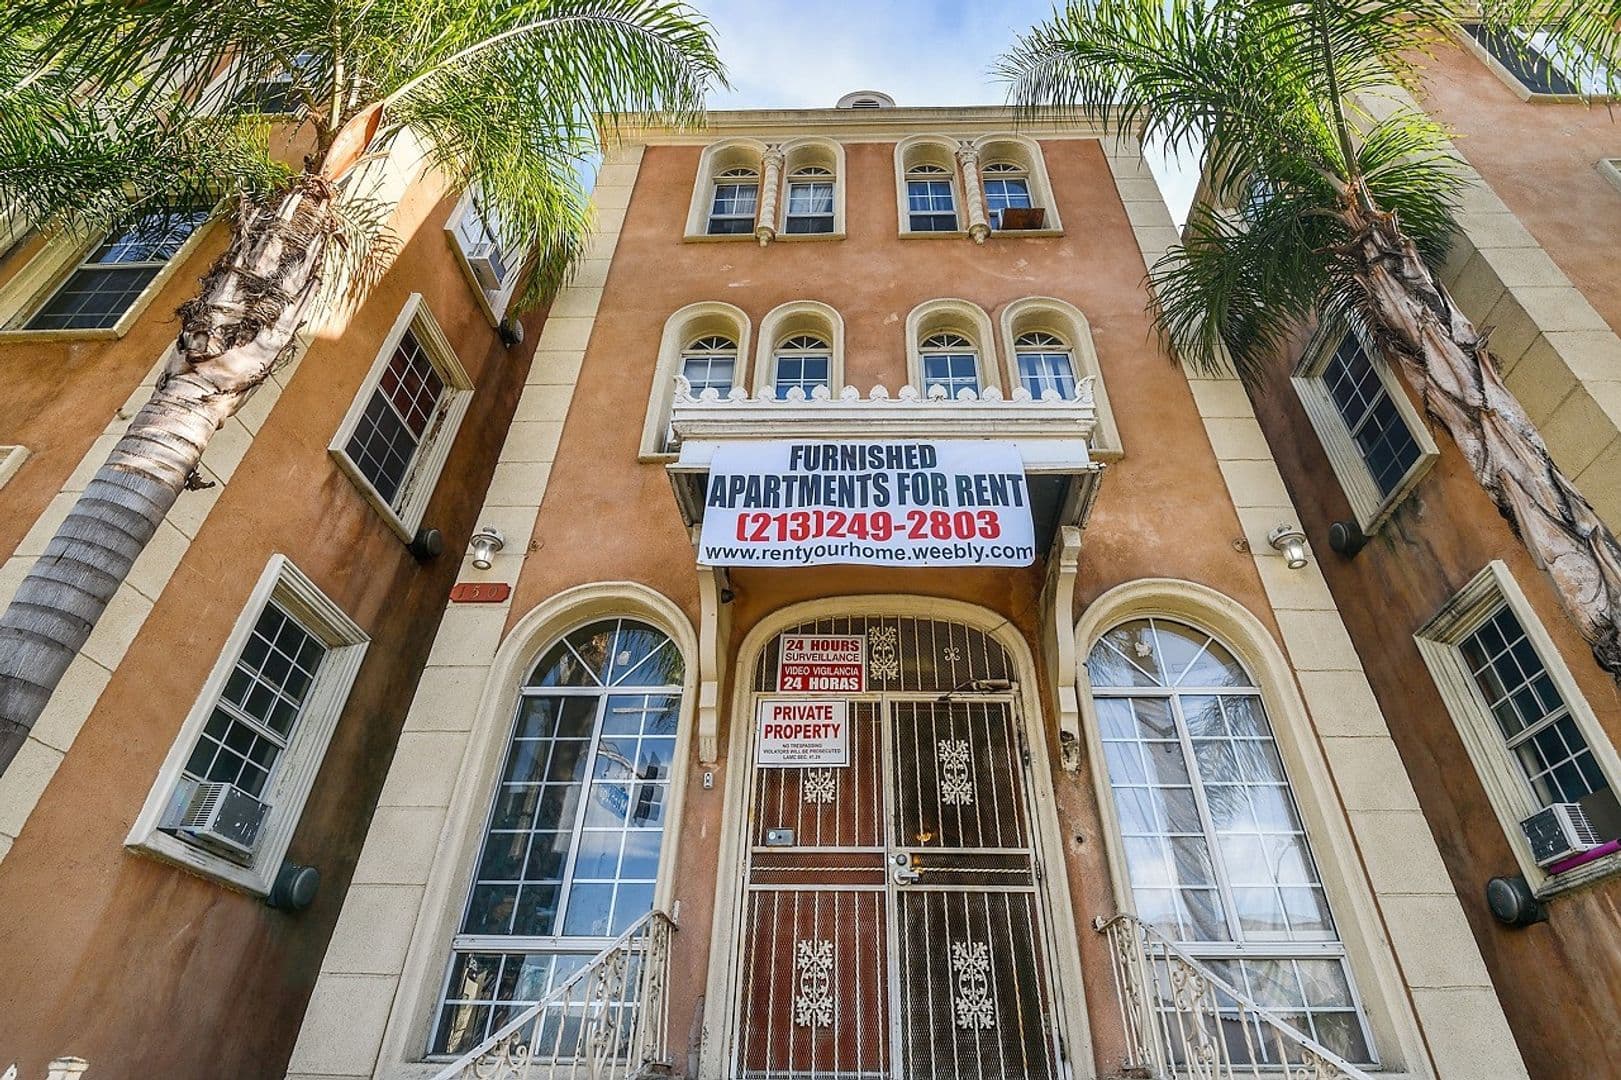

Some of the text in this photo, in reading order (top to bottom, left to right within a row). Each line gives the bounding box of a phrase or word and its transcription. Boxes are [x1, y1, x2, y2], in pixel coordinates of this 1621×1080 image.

[789, 444, 937, 472] FURNISHED
[708, 473, 1024, 508] APARTMENTS FOR RENT
[736, 510, 1001, 542] (213)249-2803
[705, 542, 1034, 563] www.rentyourhome.weebly.com
[786, 640, 860, 652] 24 HOURS
[785, 652, 859, 662] SURVEILLANCE
[785, 666, 859, 676] VIDEO VIGILANCIA
[783, 677, 859, 690] 24 HORAS
[773, 706, 833, 721] PRIVATE
[764, 724, 841, 739] PROPERTY
